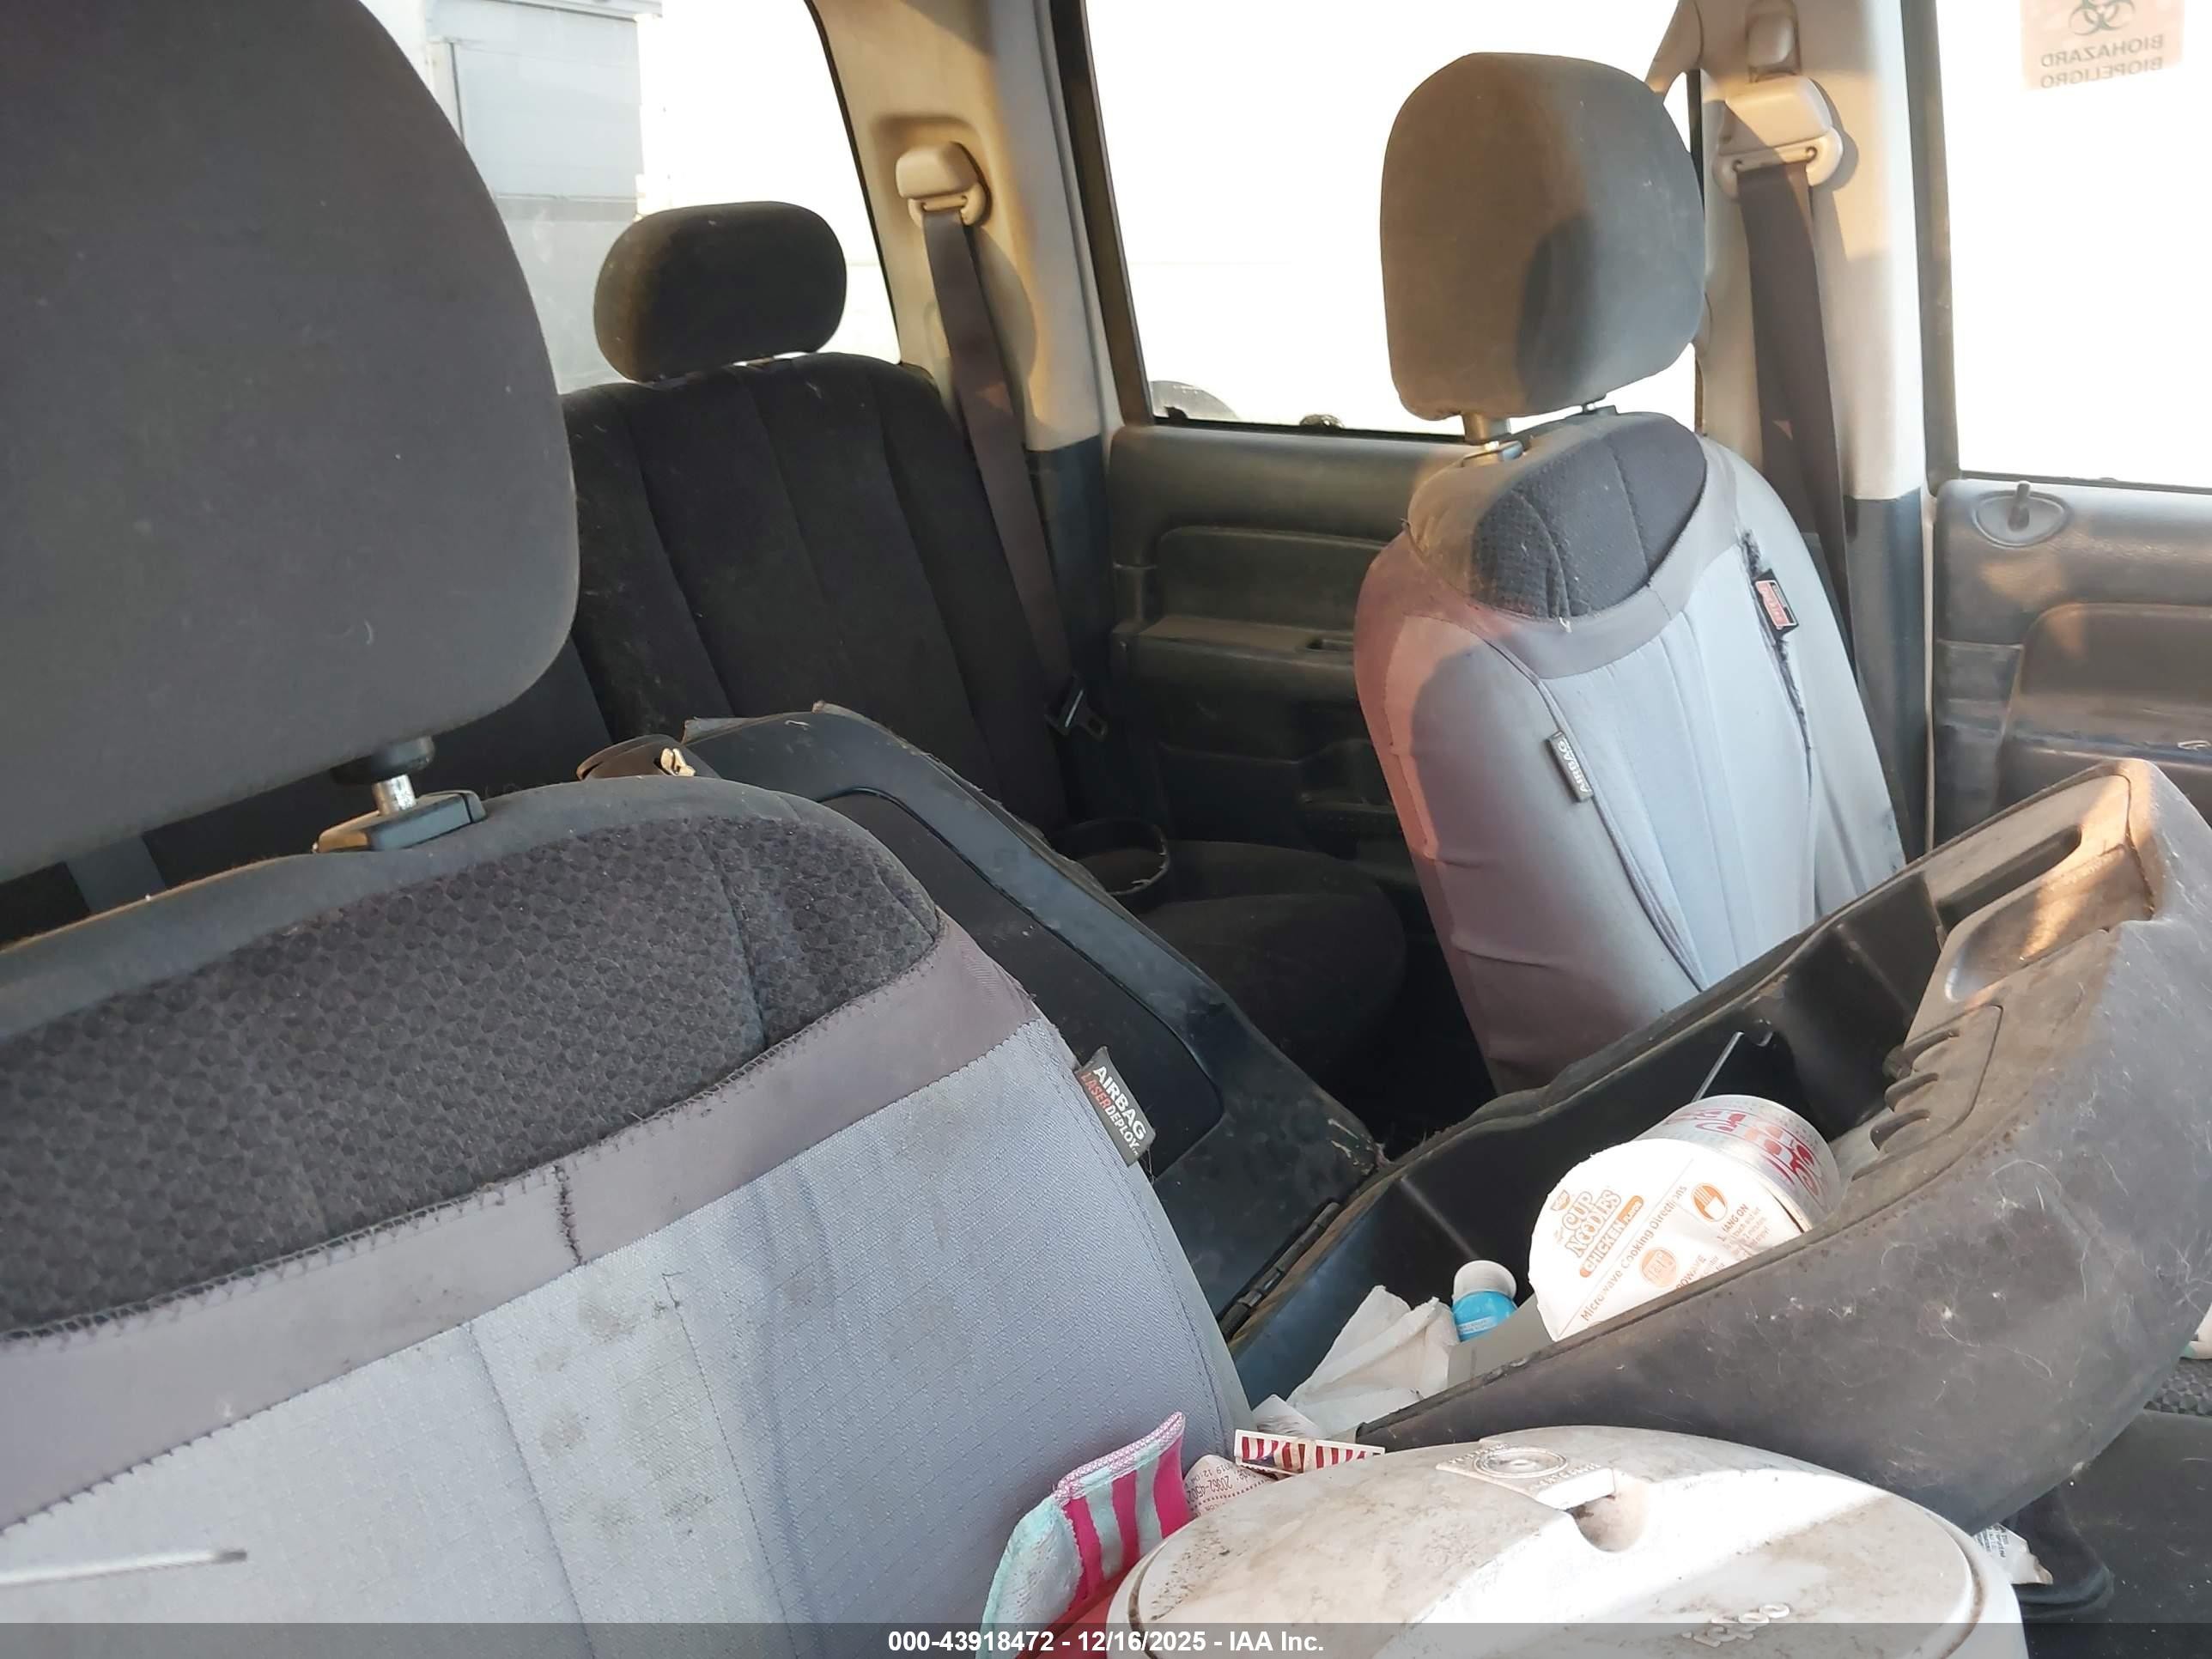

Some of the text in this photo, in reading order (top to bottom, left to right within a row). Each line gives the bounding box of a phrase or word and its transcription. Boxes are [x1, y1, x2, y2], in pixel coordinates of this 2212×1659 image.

[1093, 1066, 1147, 1140] AIRBAG
[1561, 1190, 1594, 1231] CUP
[1565, 1188, 1622, 1259] NOODLES
[1735, 1202, 1749, 1217] ON
[1581, 1217, 1630, 1273] CHICKEN
[1620, 1227, 1655, 1269] Cooking
